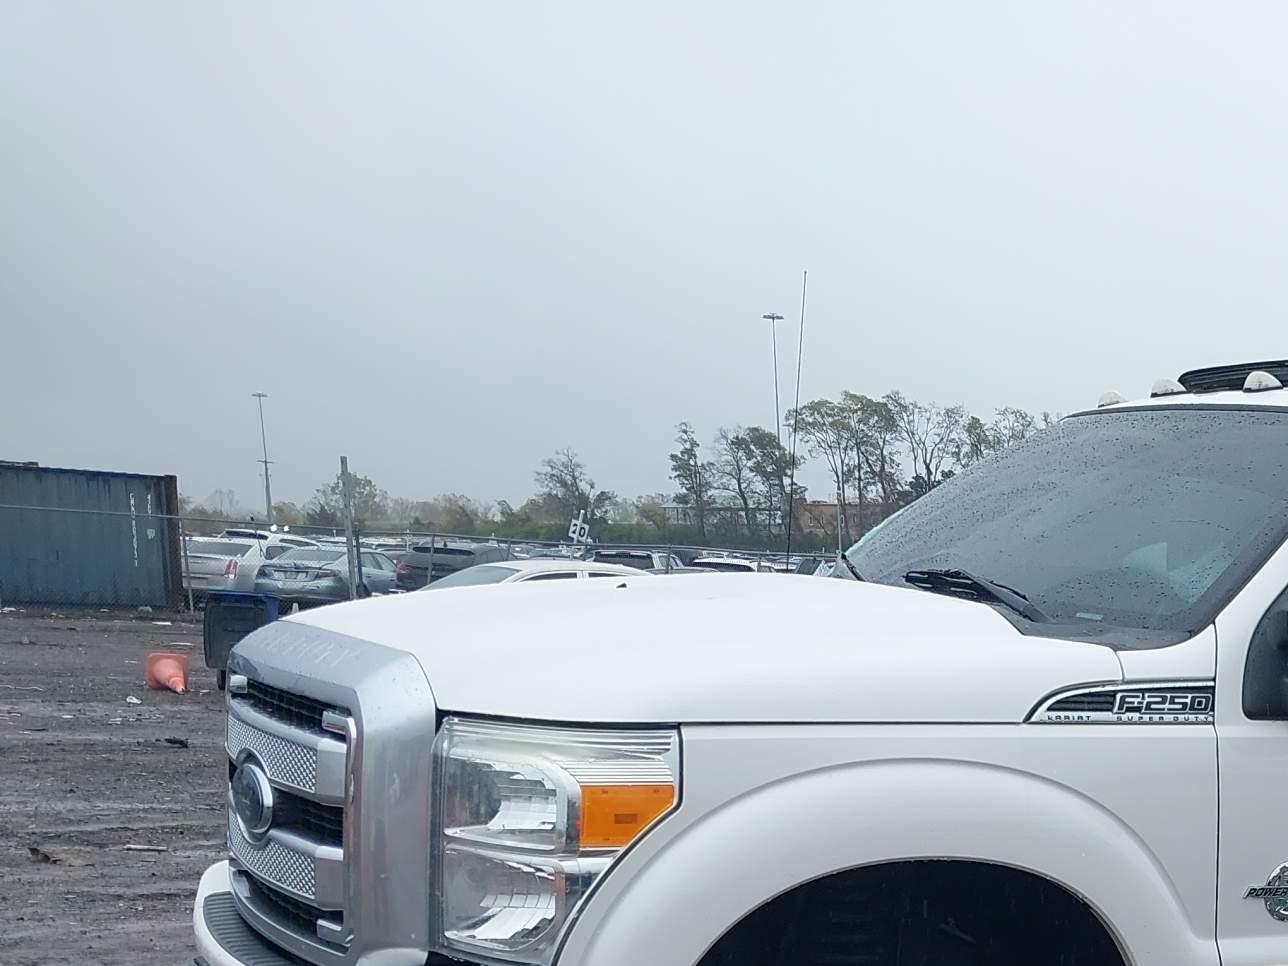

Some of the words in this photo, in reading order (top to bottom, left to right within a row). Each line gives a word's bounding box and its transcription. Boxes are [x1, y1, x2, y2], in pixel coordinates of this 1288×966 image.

[571, 523, 586, 538] 20
[1113, 692, 1213, 715] F-250
[1116, 714, 1164, 722] SUPER
[1172, 714, 1210, 722] DUTY
[1246, 886, 1288, 898] POWER
